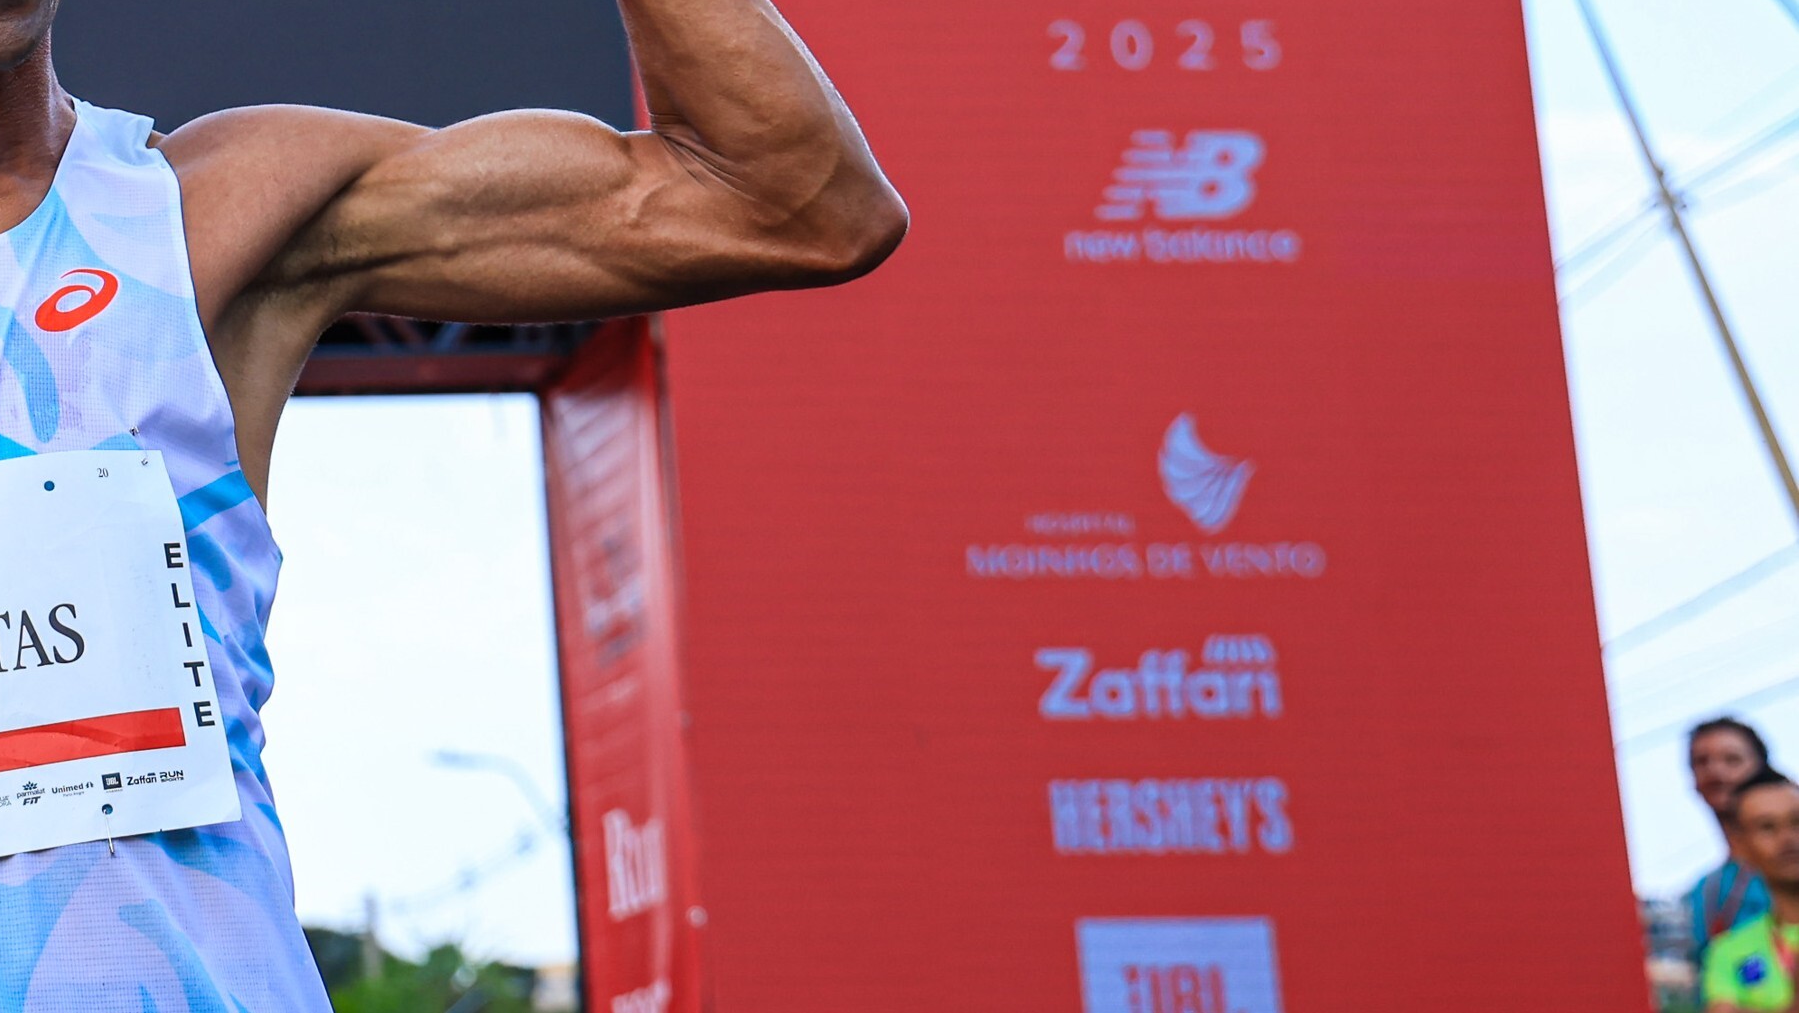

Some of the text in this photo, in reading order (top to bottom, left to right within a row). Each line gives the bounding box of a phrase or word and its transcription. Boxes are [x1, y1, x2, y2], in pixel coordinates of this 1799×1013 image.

[1046, 19, 1282, 71] 2025
[97, 468, 109, 478] 20
[164, 543, 215, 727] ELITE
[1034, 640, 1283, 720] Zaffari
[159, 770, 184, 778] RUN
[126, 774, 157, 786] Zaffari
[16, 788, 46, 799] parmalat
[51, 783, 83, 794] Unimed
